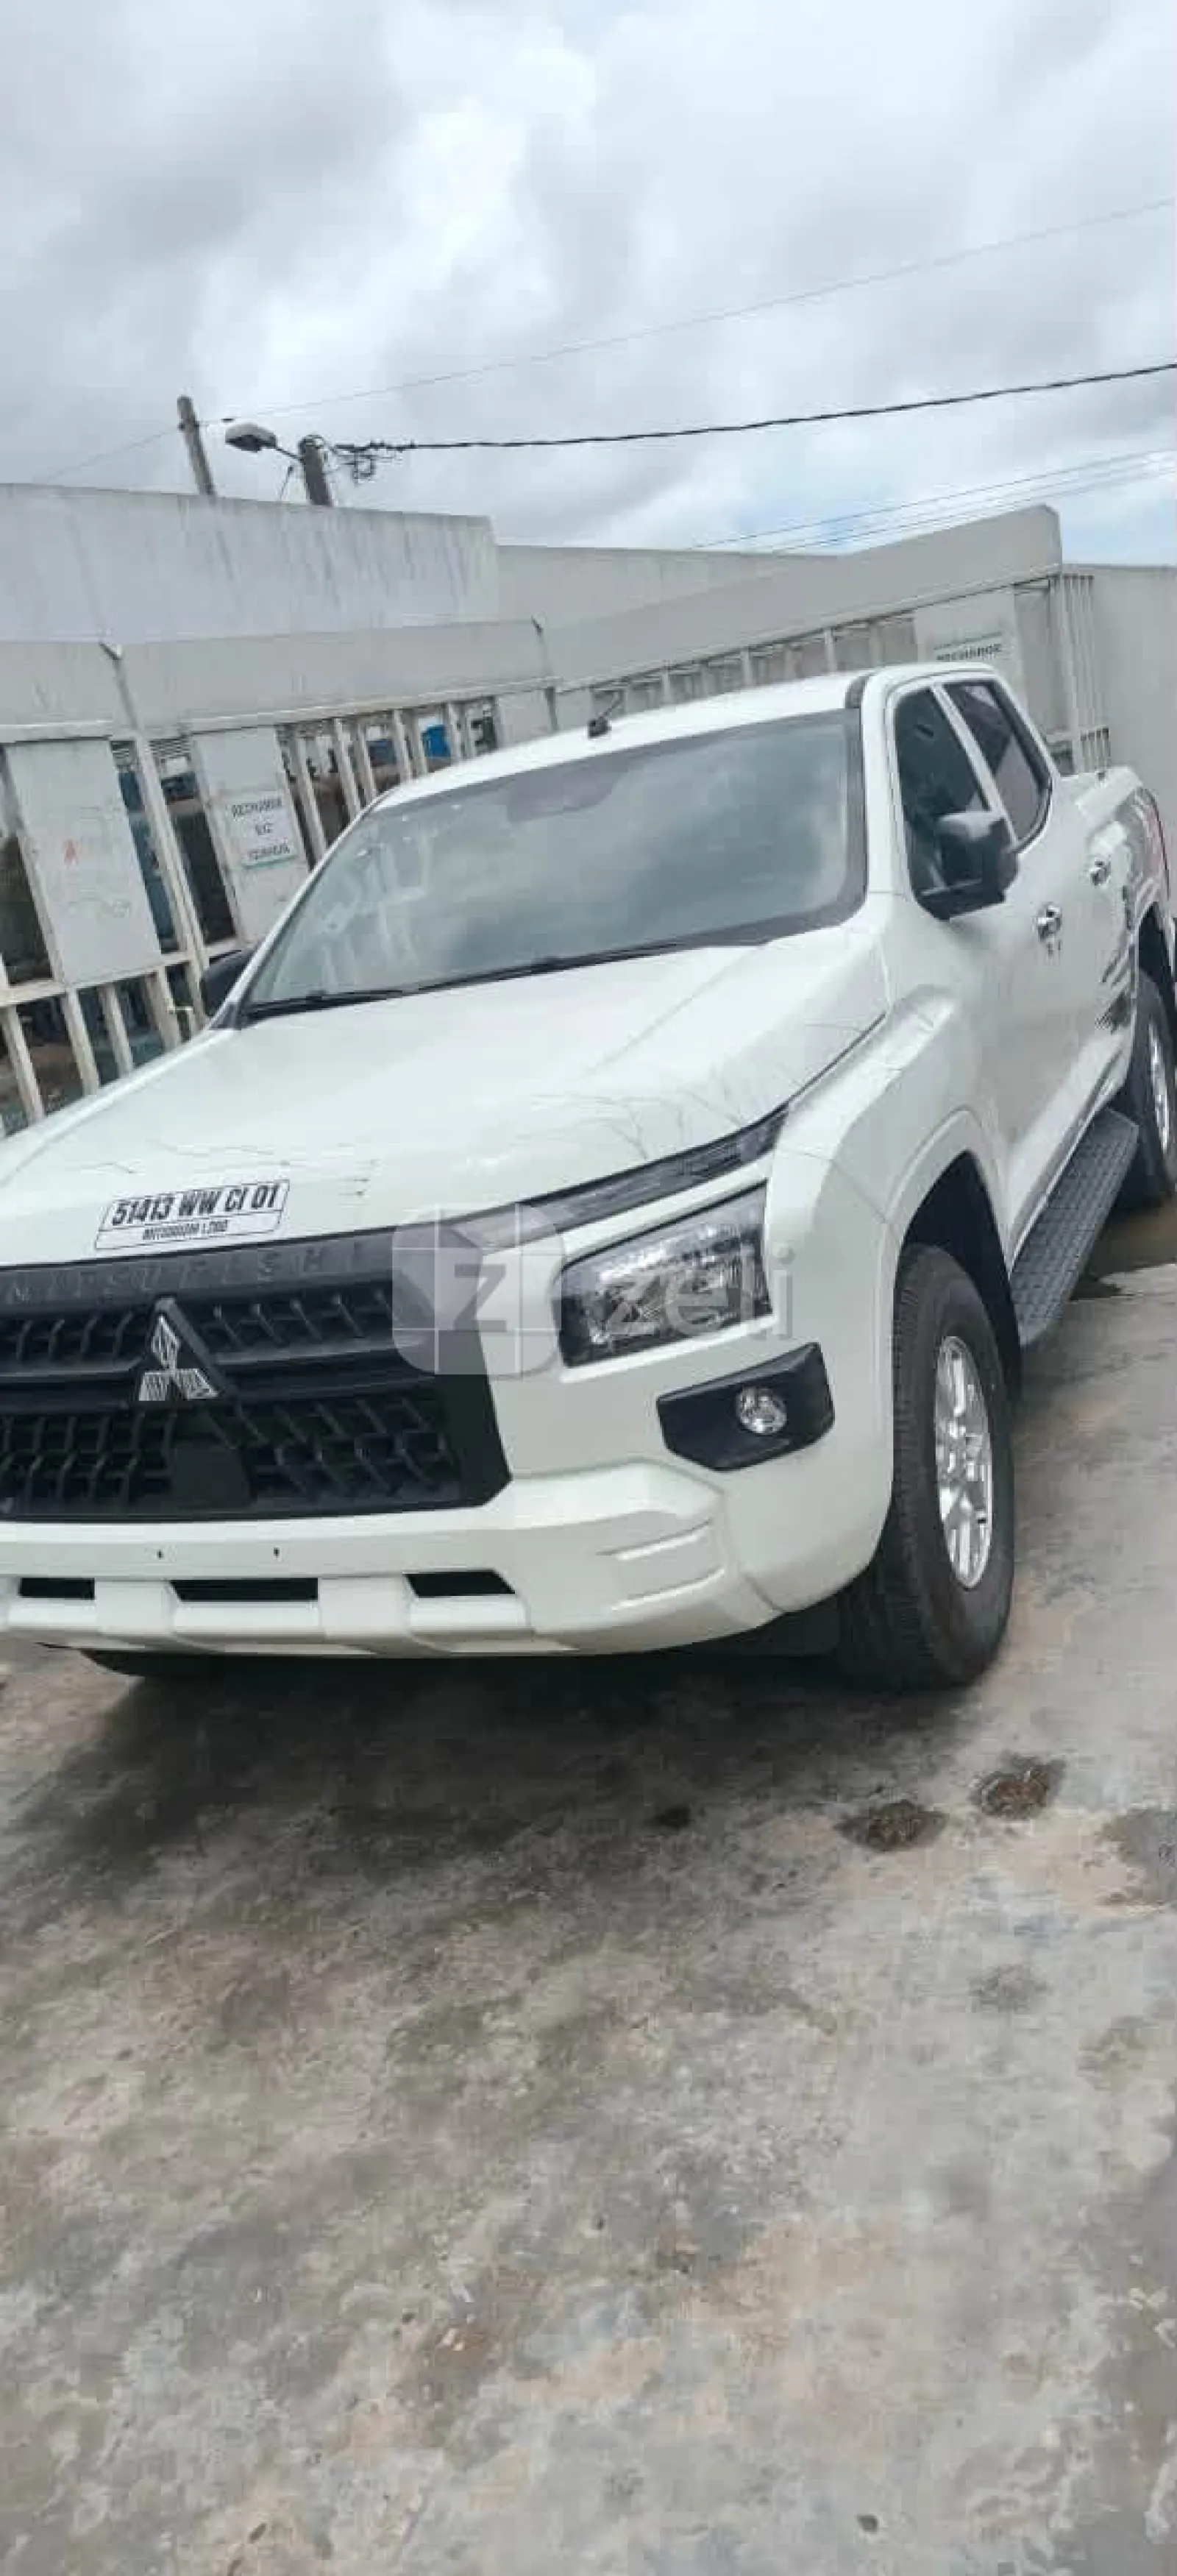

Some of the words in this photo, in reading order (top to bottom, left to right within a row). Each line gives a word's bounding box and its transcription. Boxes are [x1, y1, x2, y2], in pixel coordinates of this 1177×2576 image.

[112, 1197, 174, 1227] 51413
[179, 1191, 222, 1216] WW
[225, 1187, 249, 1213] CI
[251, 1184, 280, 1210] 01
